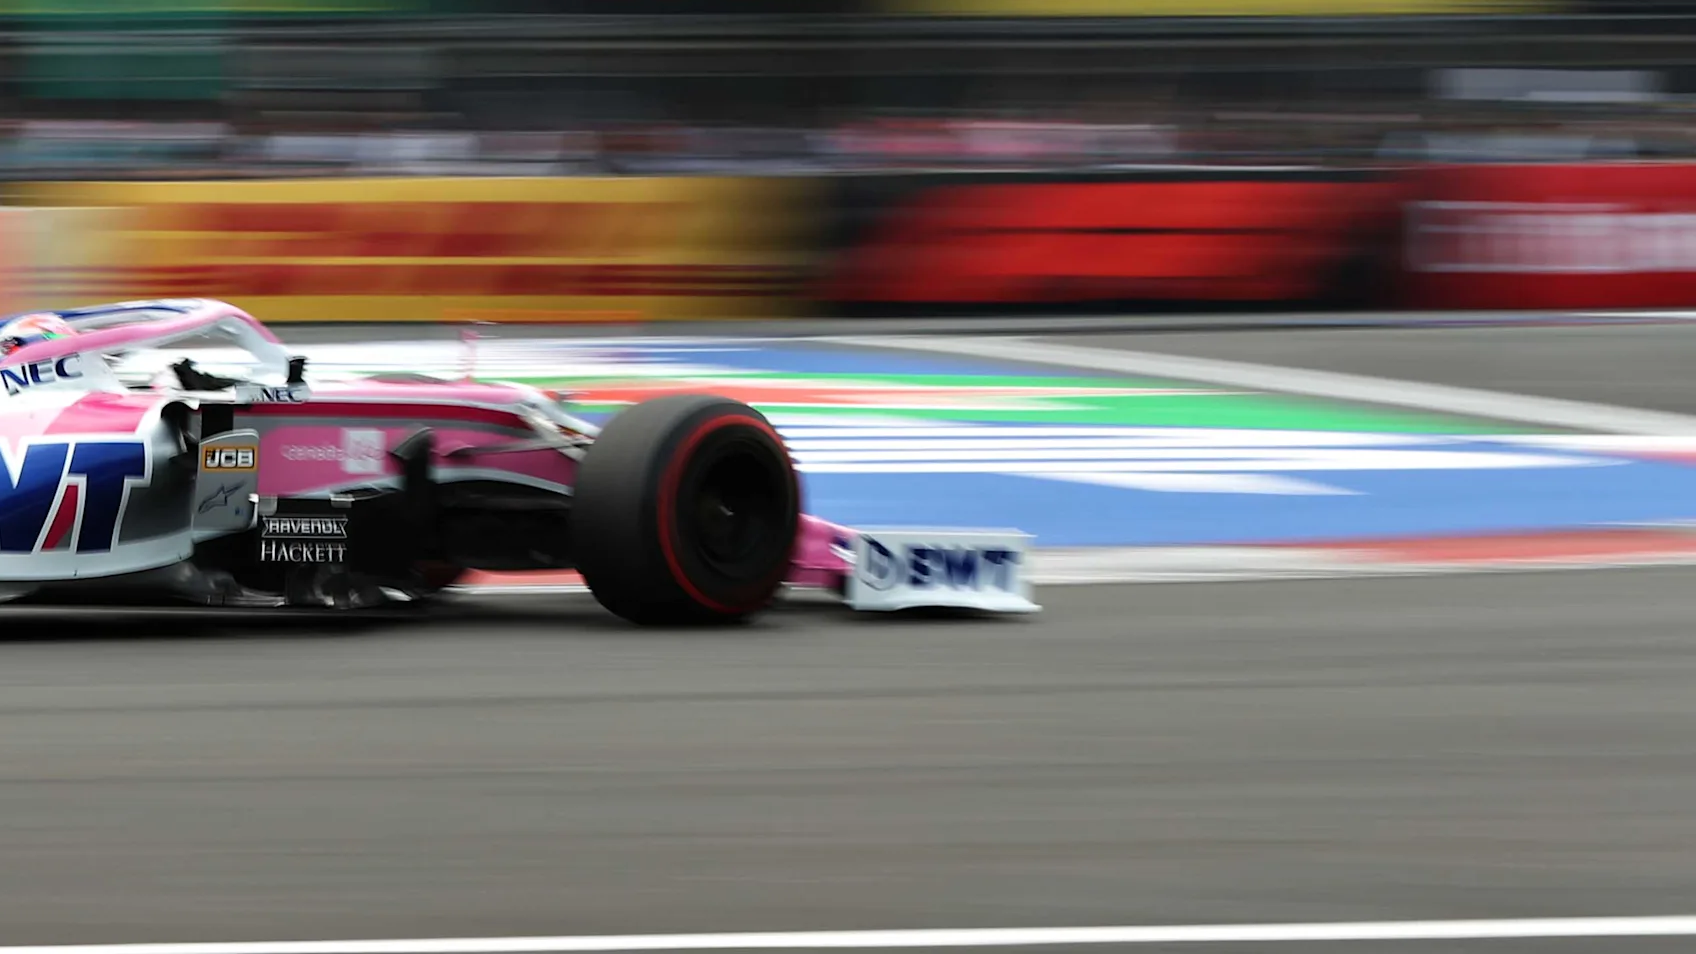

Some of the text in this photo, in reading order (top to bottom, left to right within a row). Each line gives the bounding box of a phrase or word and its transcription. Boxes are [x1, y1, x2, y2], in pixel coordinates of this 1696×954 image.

[0, 352, 83, 396] NEC
[262, 387, 302, 402] NEC
[205, 448, 254, 468] JCB
[260, 540, 347, 562] HACKETT
